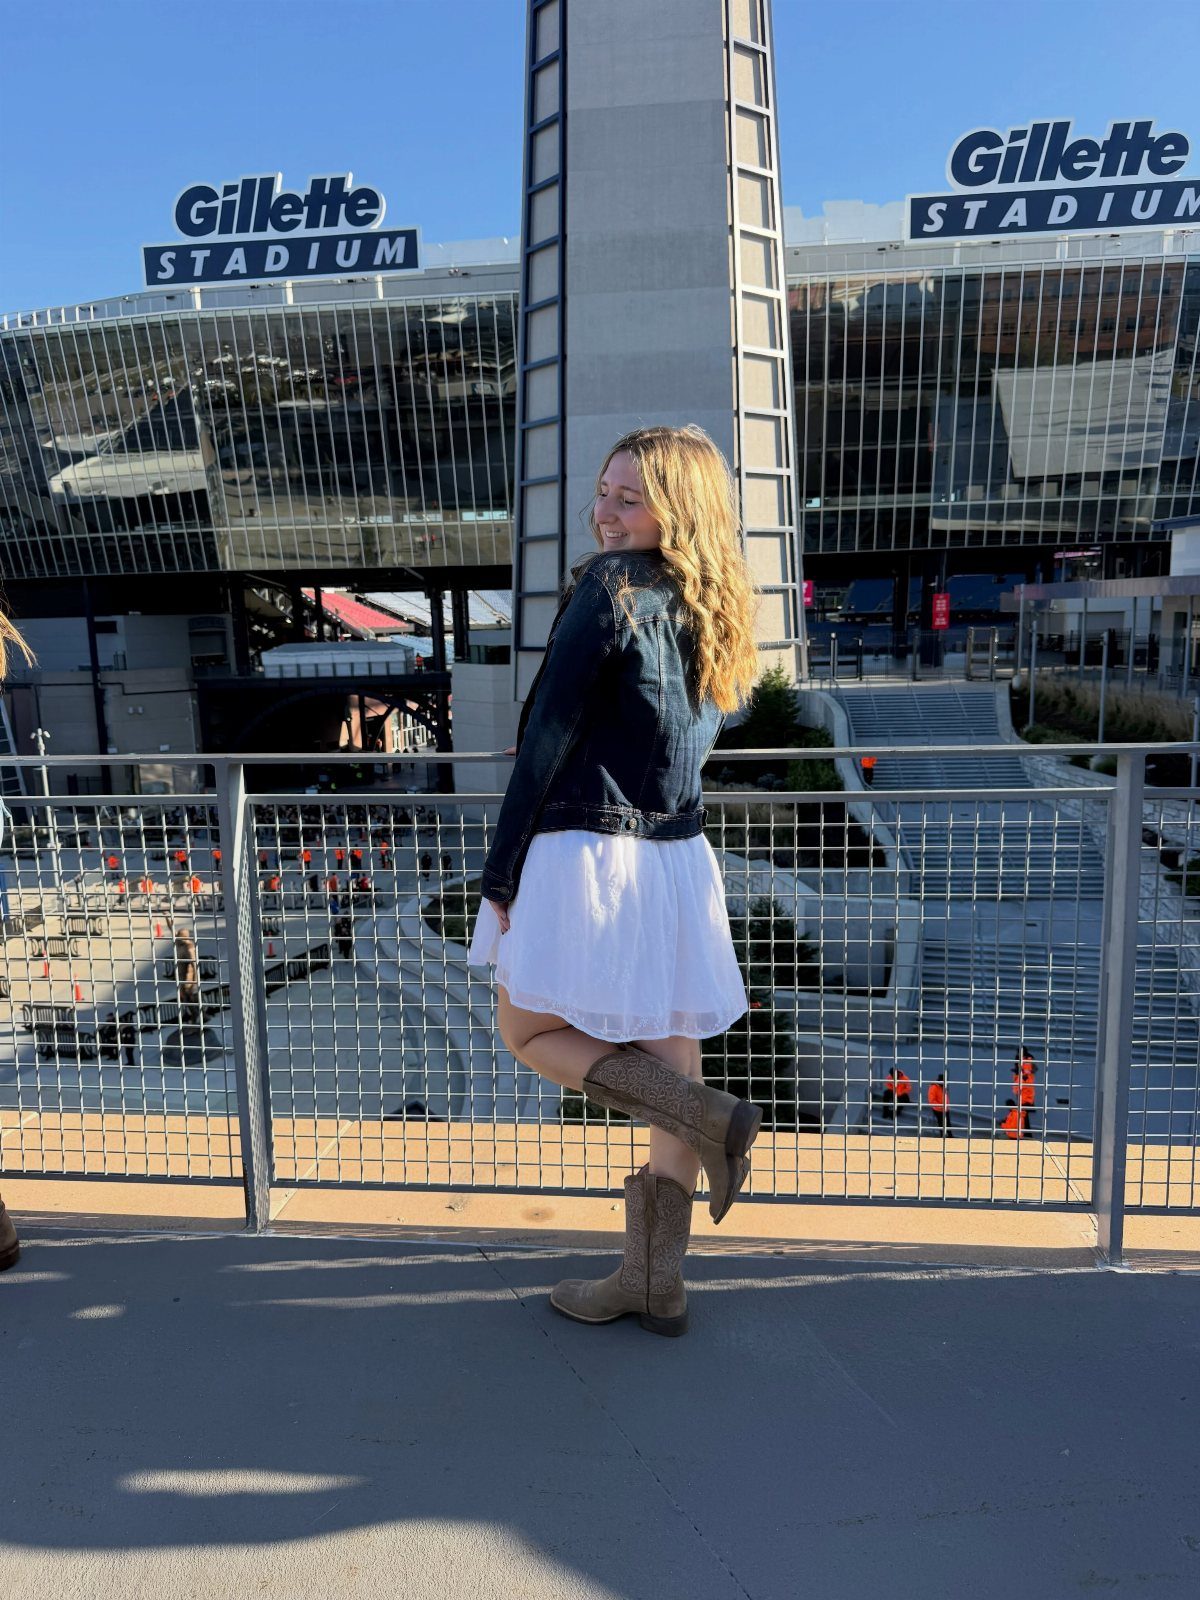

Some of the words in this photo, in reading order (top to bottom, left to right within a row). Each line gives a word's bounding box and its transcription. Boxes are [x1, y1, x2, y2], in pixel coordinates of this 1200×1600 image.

[950, 120, 1190, 187] Gillette
[174, 176, 380, 238] Gillette
[922, 187, 1200, 233] STADIUM
[156, 236, 407, 280] STADIUM
